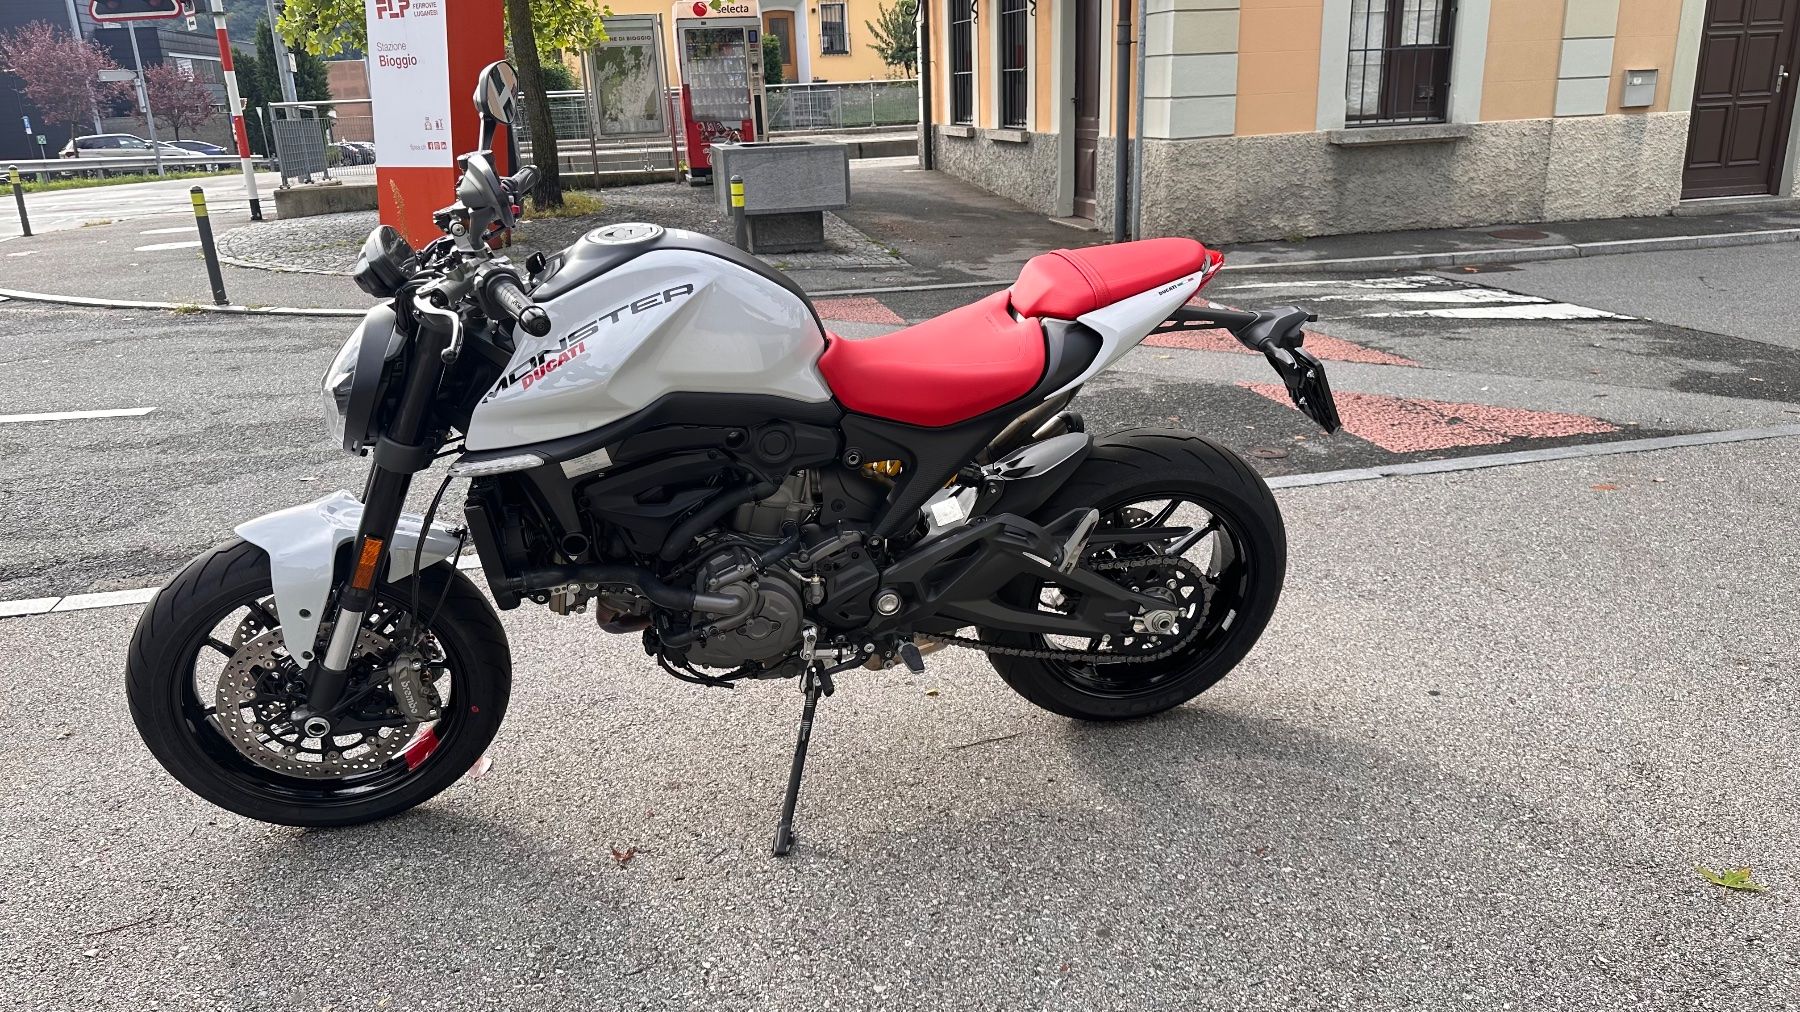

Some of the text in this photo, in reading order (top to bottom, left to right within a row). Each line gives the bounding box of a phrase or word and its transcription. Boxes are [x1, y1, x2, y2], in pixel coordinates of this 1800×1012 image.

[375, 0, 410, 20] FLP
[413, 2, 437, 10] FERROVIE
[414, 9, 438, 17] LUGANESI
[376, 41, 407, 52] Stazione
[379, 53, 418, 69] Bioggio
[1158, 285, 1177, 295] DUCATI
[481, 283, 694, 404] MONSTER
[521, 341, 586, 391] DUCATI
[401, 680, 418, 713] brembo
